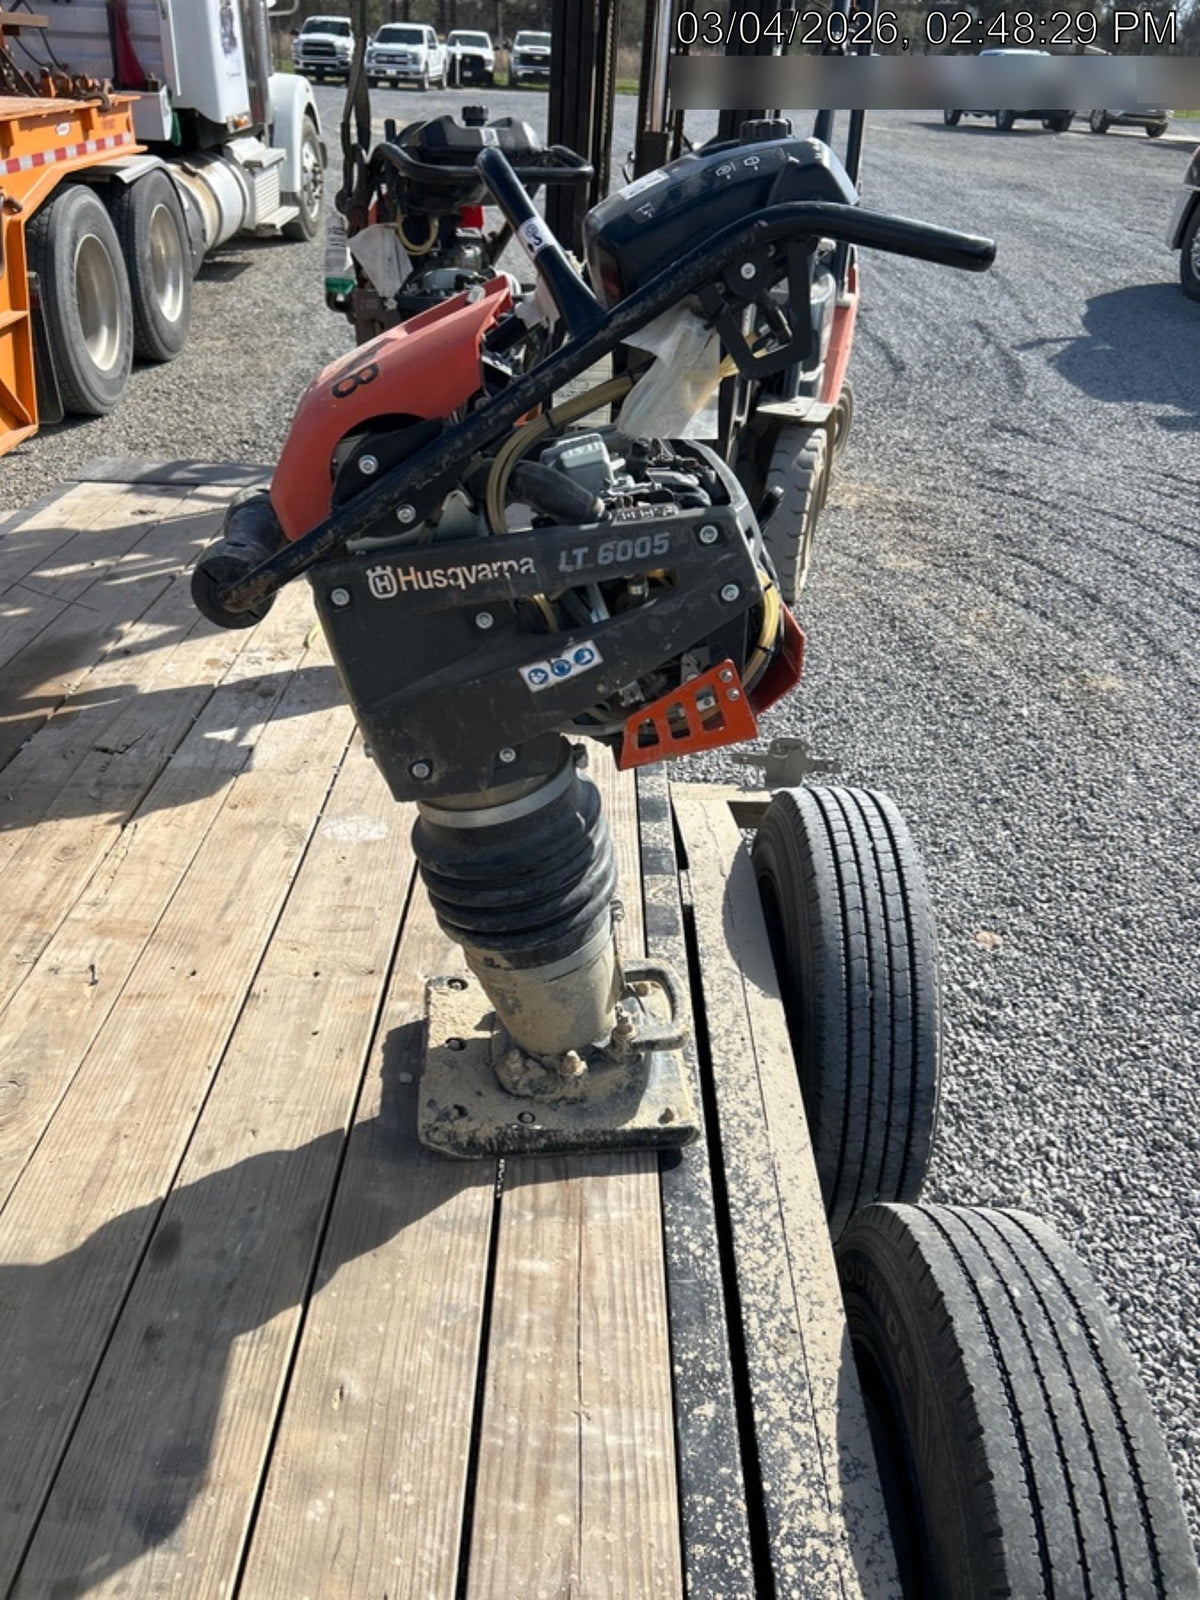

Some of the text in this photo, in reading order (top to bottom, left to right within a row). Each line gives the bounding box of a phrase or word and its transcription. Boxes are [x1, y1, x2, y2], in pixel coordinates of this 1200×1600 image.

[558, 531, 670, 572] LT 6005
[397, 557, 536, 591] Husqvarna
